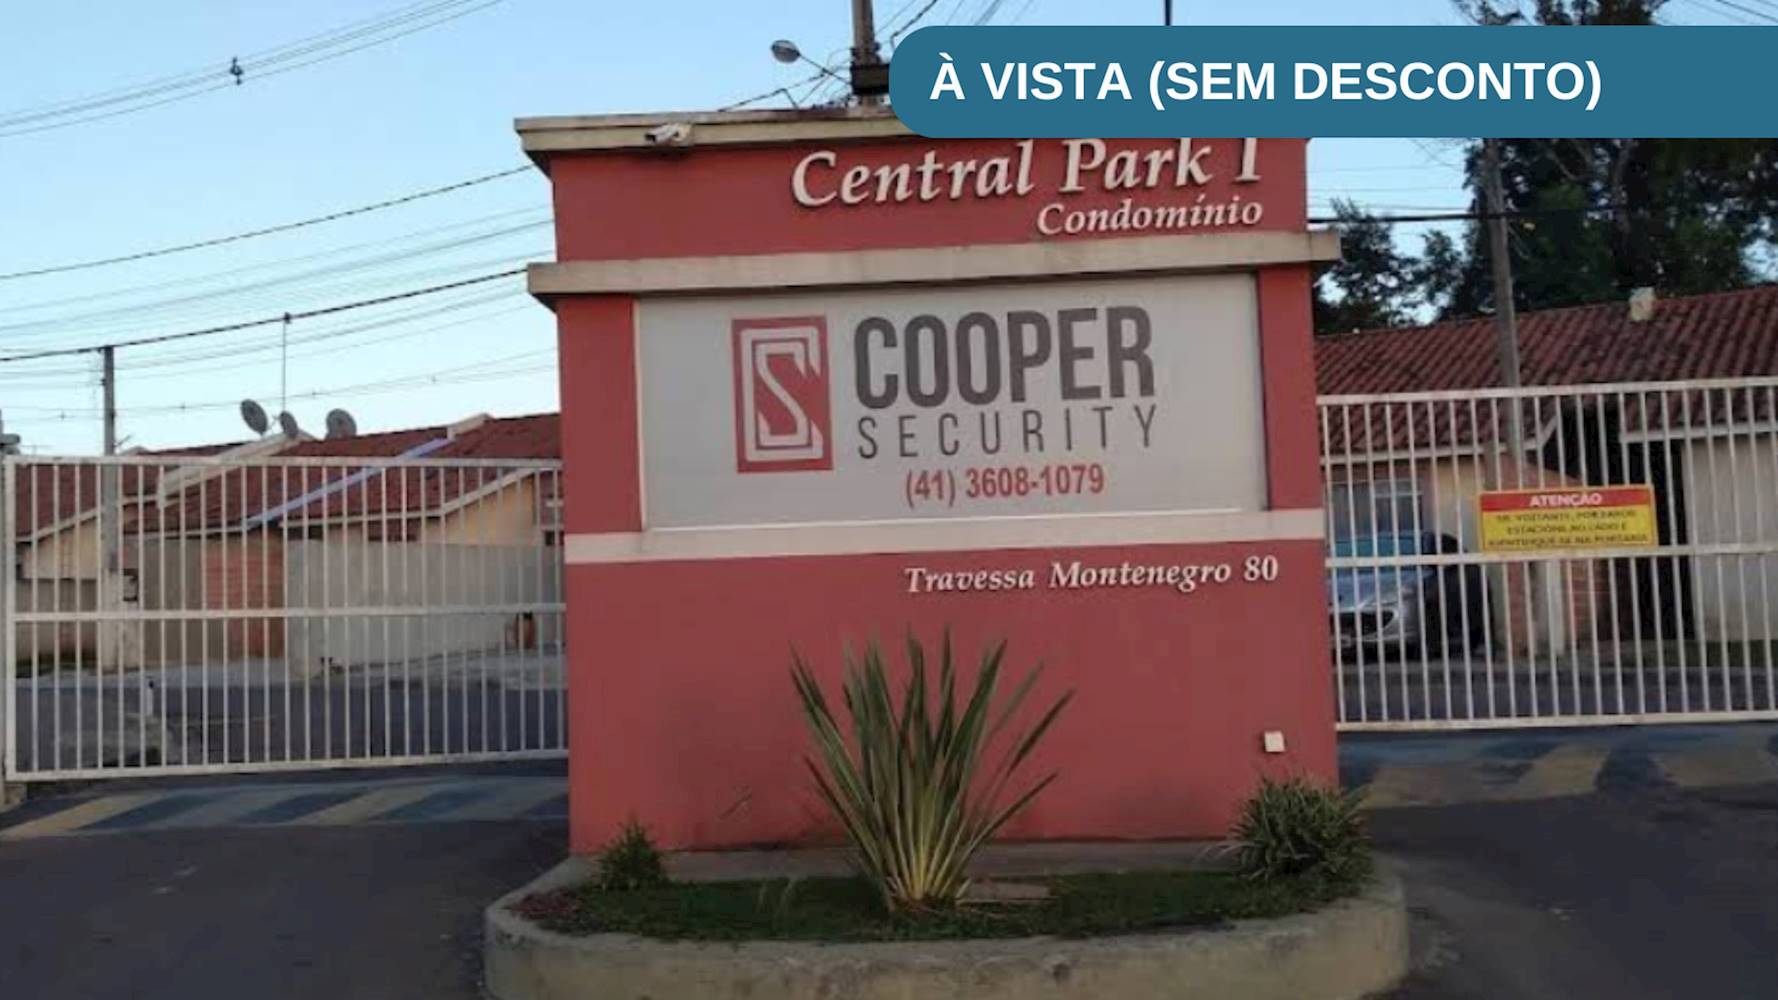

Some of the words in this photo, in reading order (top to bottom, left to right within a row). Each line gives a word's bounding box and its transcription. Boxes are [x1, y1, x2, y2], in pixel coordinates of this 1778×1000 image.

[791, 141, 1036, 208] Central
[1059, 138, 1213, 193] Park
[1037, 195, 1263, 236] Condomínio
[854, 306, 1155, 409] COOPER
[858, 404, 1157, 459] SECURITY
[906, 470, 956, 508] (41)
[966, 464, 1104, 499] 3608-1079
[1529, 492, 1602, 507] ATENÇÃO
[905, 567, 1034, 592] Travessa
[1049, 562, 1231, 592] Montenegro
[1244, 555, 1279, 581] 80
